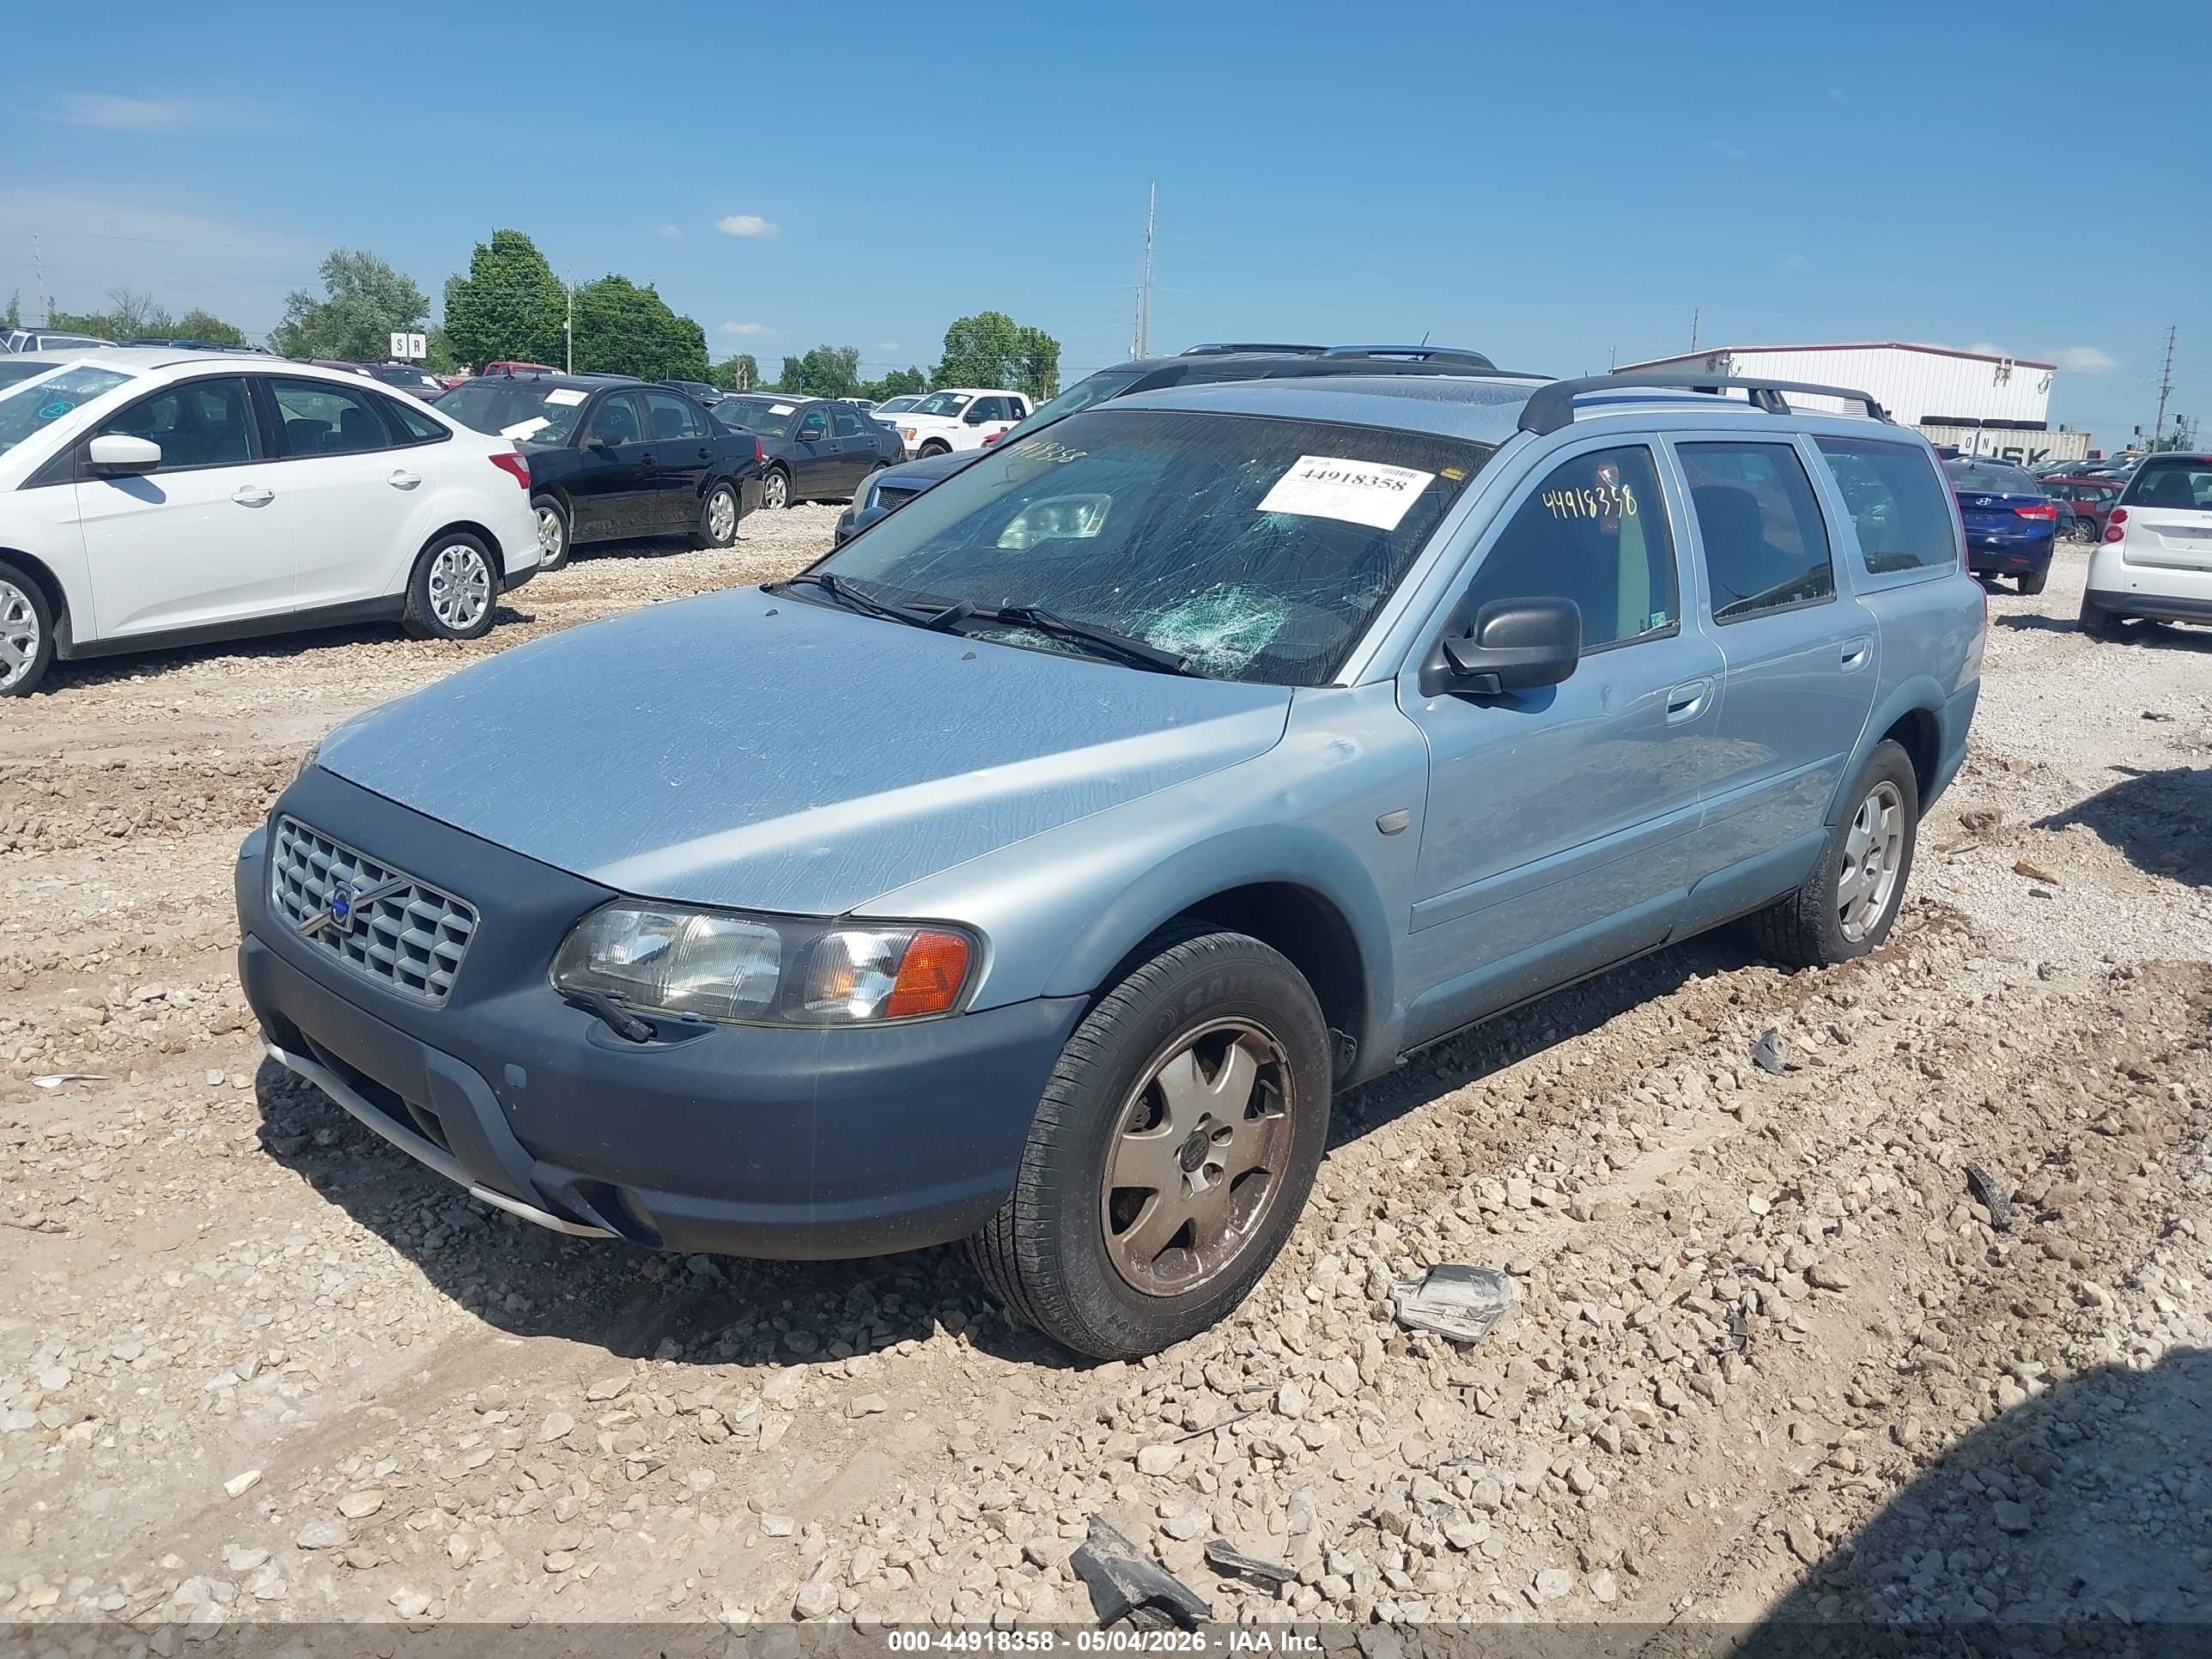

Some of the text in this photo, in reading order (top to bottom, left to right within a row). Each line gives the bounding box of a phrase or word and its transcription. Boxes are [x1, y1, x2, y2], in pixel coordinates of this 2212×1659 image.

[397, 338, 403, 351] S
[414, 340, 420, 352] R
[1982, 437, 1990, 449] N
[1299, 468, 1408, 492] 44918358
[1542, 484, 1638, 520] 44918358
